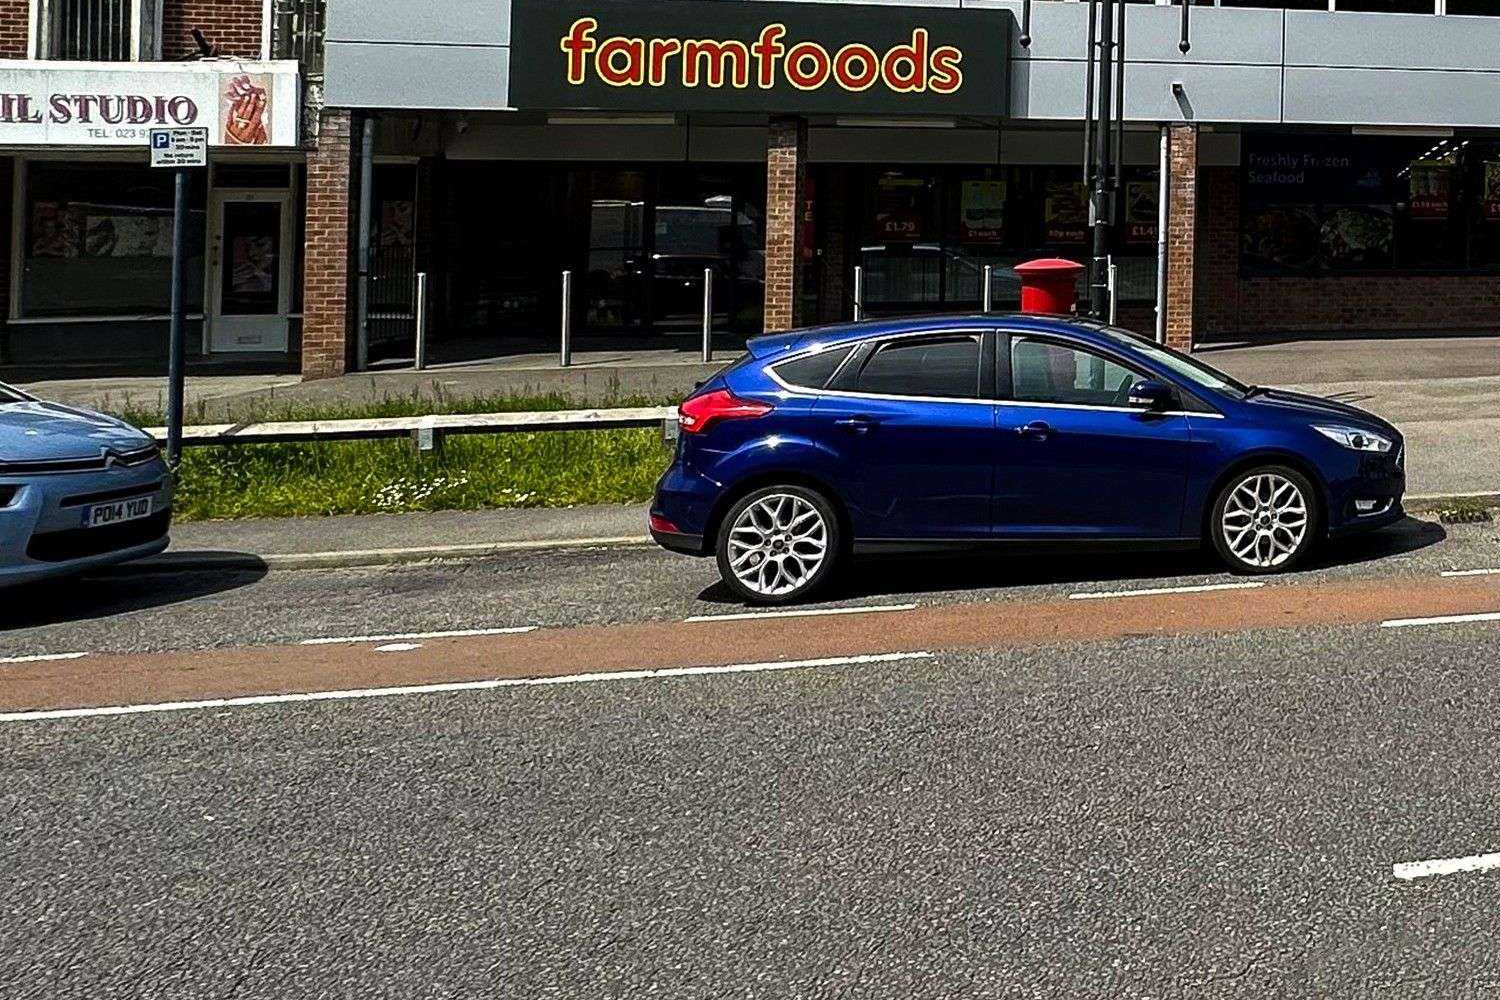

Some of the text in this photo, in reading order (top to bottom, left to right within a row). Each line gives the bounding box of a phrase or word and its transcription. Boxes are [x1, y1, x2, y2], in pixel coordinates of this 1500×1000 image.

[561, 17, 963, 94] farmfoods
[49, 93, 199, 126] STUDIO
[115, 128, 136, 138] 023
[1248, 169, 1304, 185] Seafood
